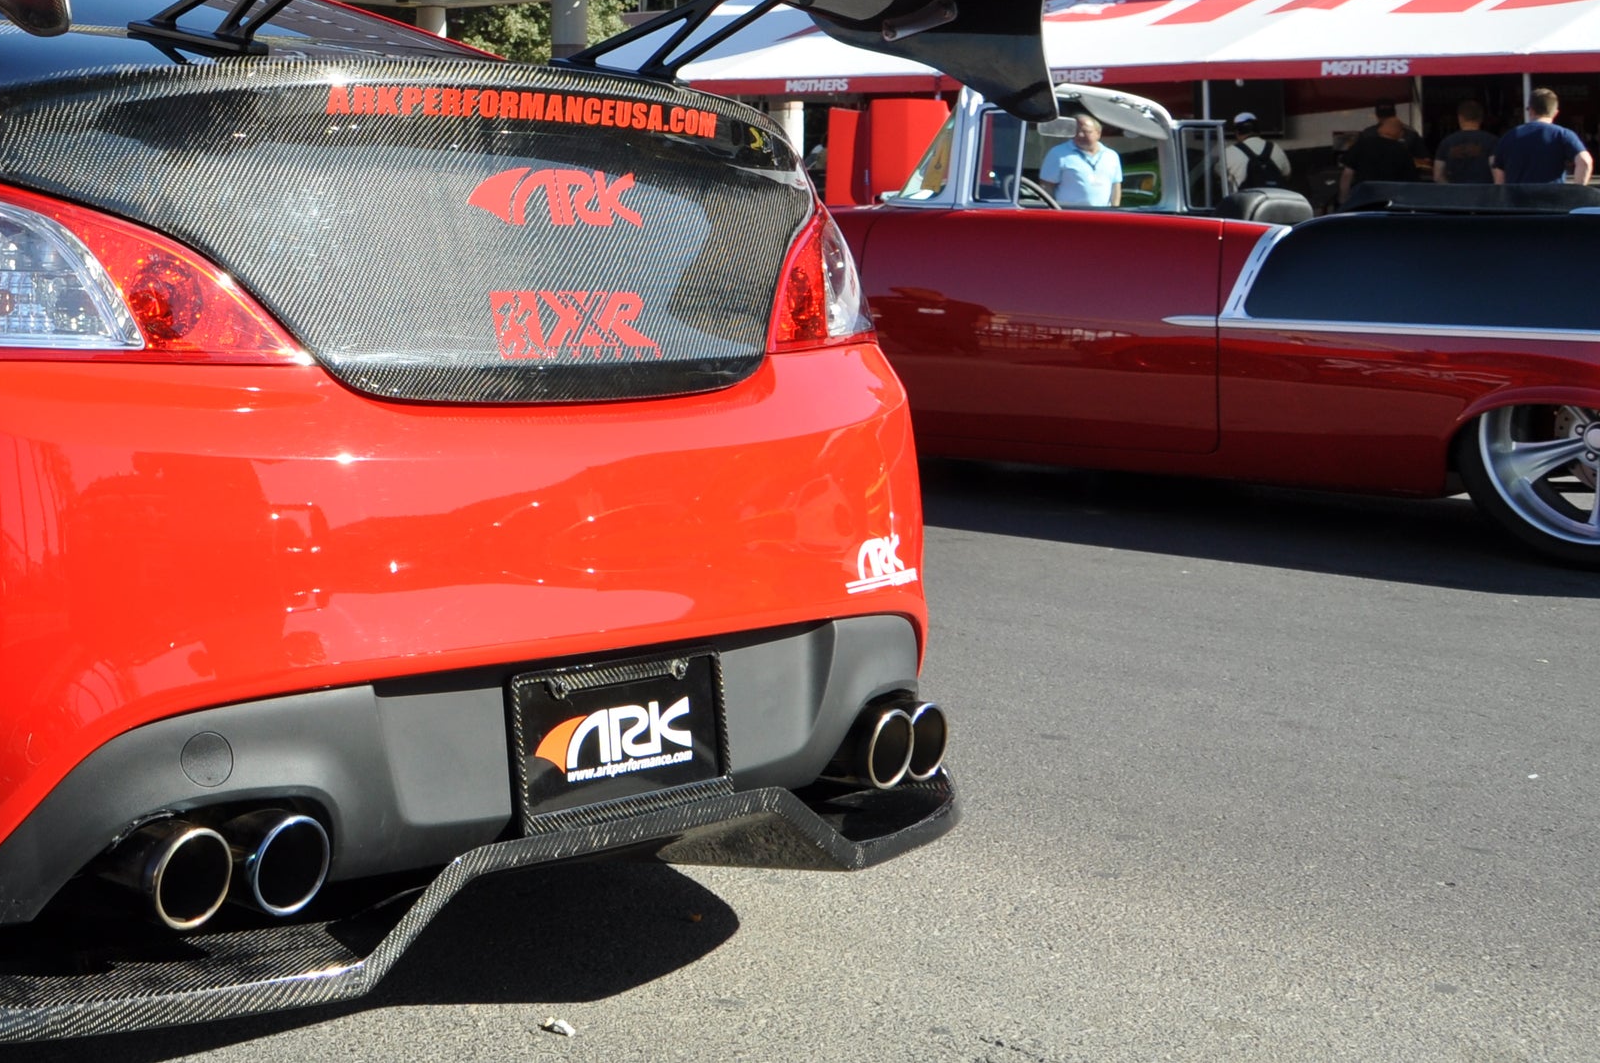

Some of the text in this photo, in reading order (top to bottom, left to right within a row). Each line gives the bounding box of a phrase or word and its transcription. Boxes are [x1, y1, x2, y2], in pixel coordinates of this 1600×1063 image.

[785, 78, 848, 93] MOTHERS
[1321, 59, 1410, 76] MOTHERS
[325, 85, 718, 139] ARKPERFORMANCEUSA.COM
[505, 167, 644, 228] ARK
[857, 534, 906, 579] ARK
[566, 696, 693, 770] ARK
[566, 750, 693, 783] www.arkperformance.com
